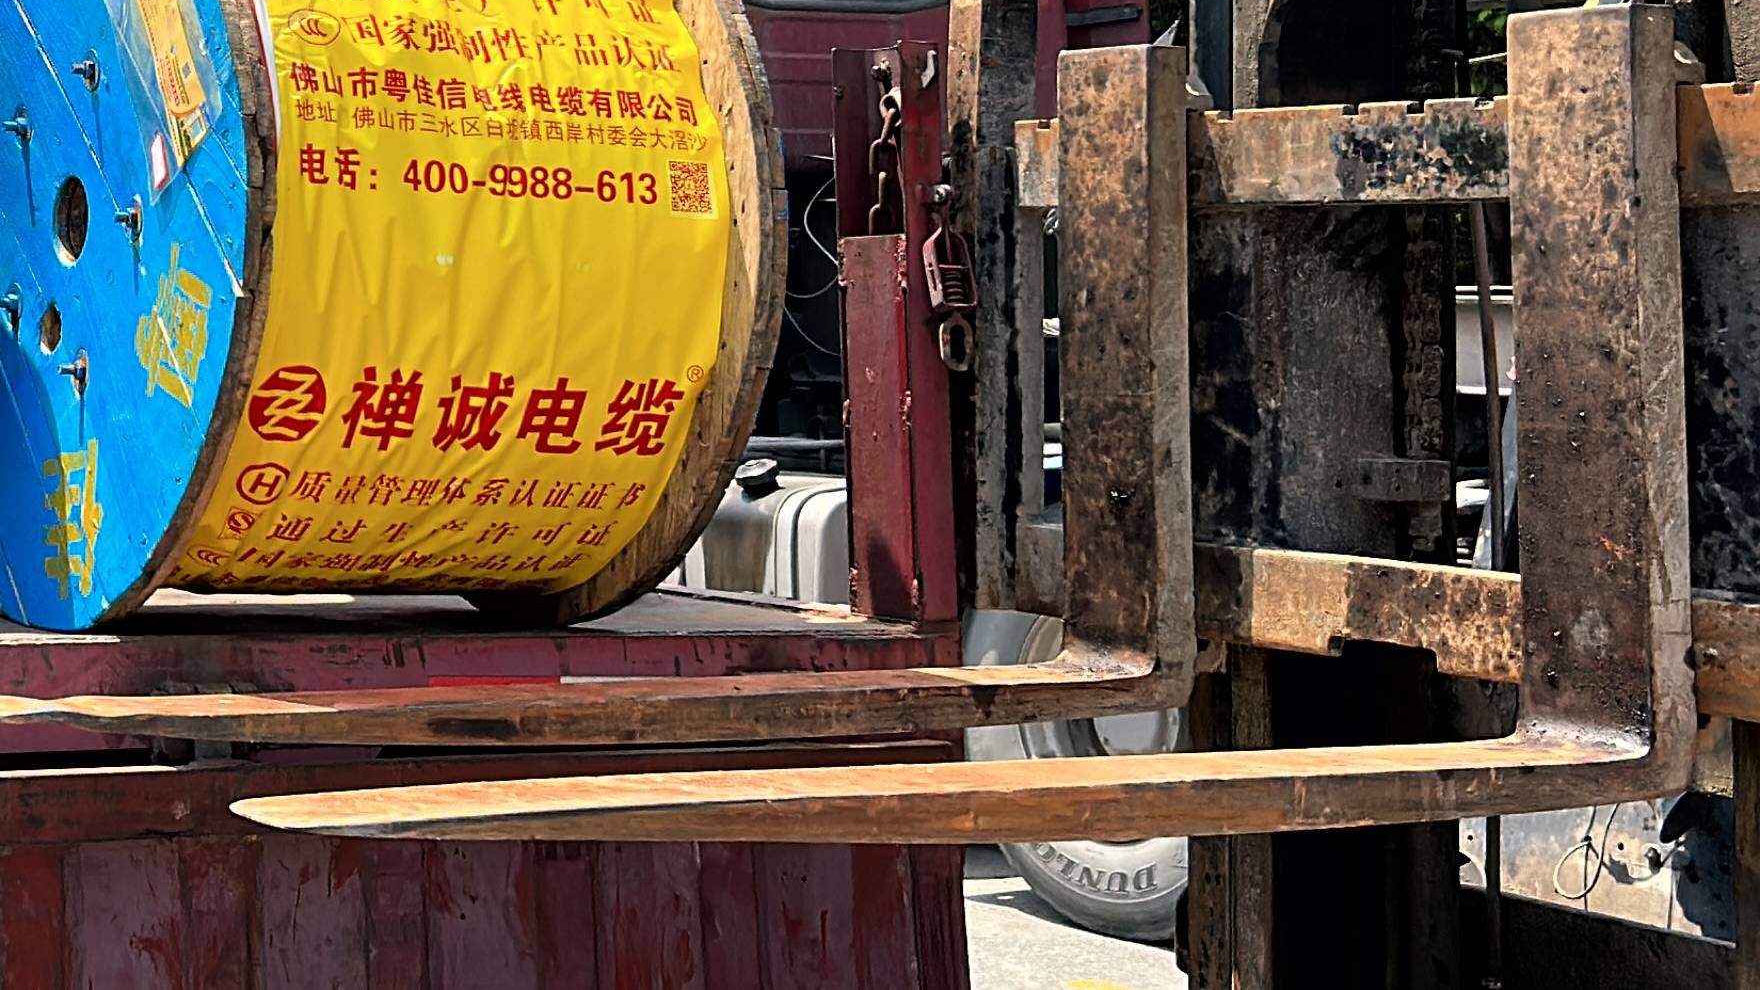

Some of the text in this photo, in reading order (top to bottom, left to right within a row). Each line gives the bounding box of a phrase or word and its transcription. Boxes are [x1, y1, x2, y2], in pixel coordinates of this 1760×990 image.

[403, 159, 658, 205] 400-9988-613
[340, 366, 687, 456] 禅诚电缆
[290, 471, 647, 511] 质量管理体系认证证书
[265, 513, 620, 548] 通过生产许可证
